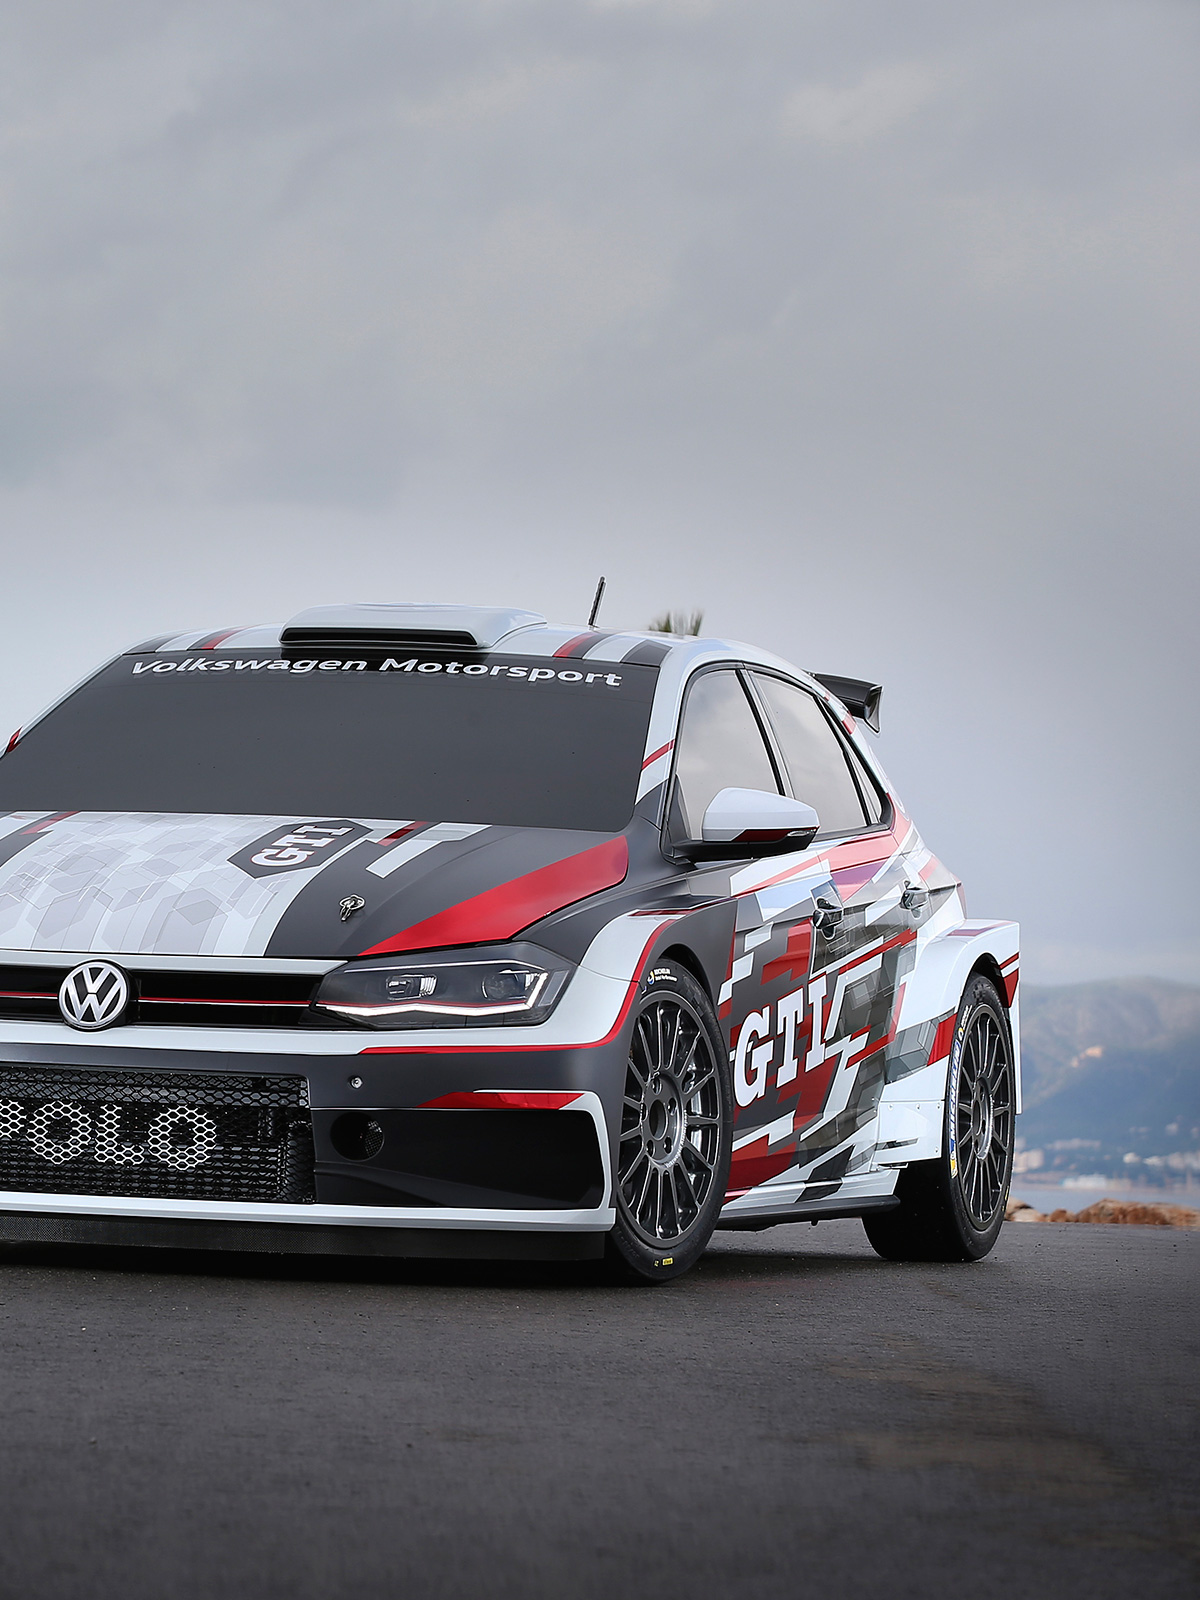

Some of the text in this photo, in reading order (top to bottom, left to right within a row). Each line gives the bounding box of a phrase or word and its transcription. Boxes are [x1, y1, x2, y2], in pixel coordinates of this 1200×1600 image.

[132, 658, 623, 686] Volkswagen Motorsport
[251, 825, 355, 866] GTI
[60, 962, 127, 1027] VW
[734, 975, 827, 1107] GTI
[950, 1042, 961, 1140] MICHELIN
